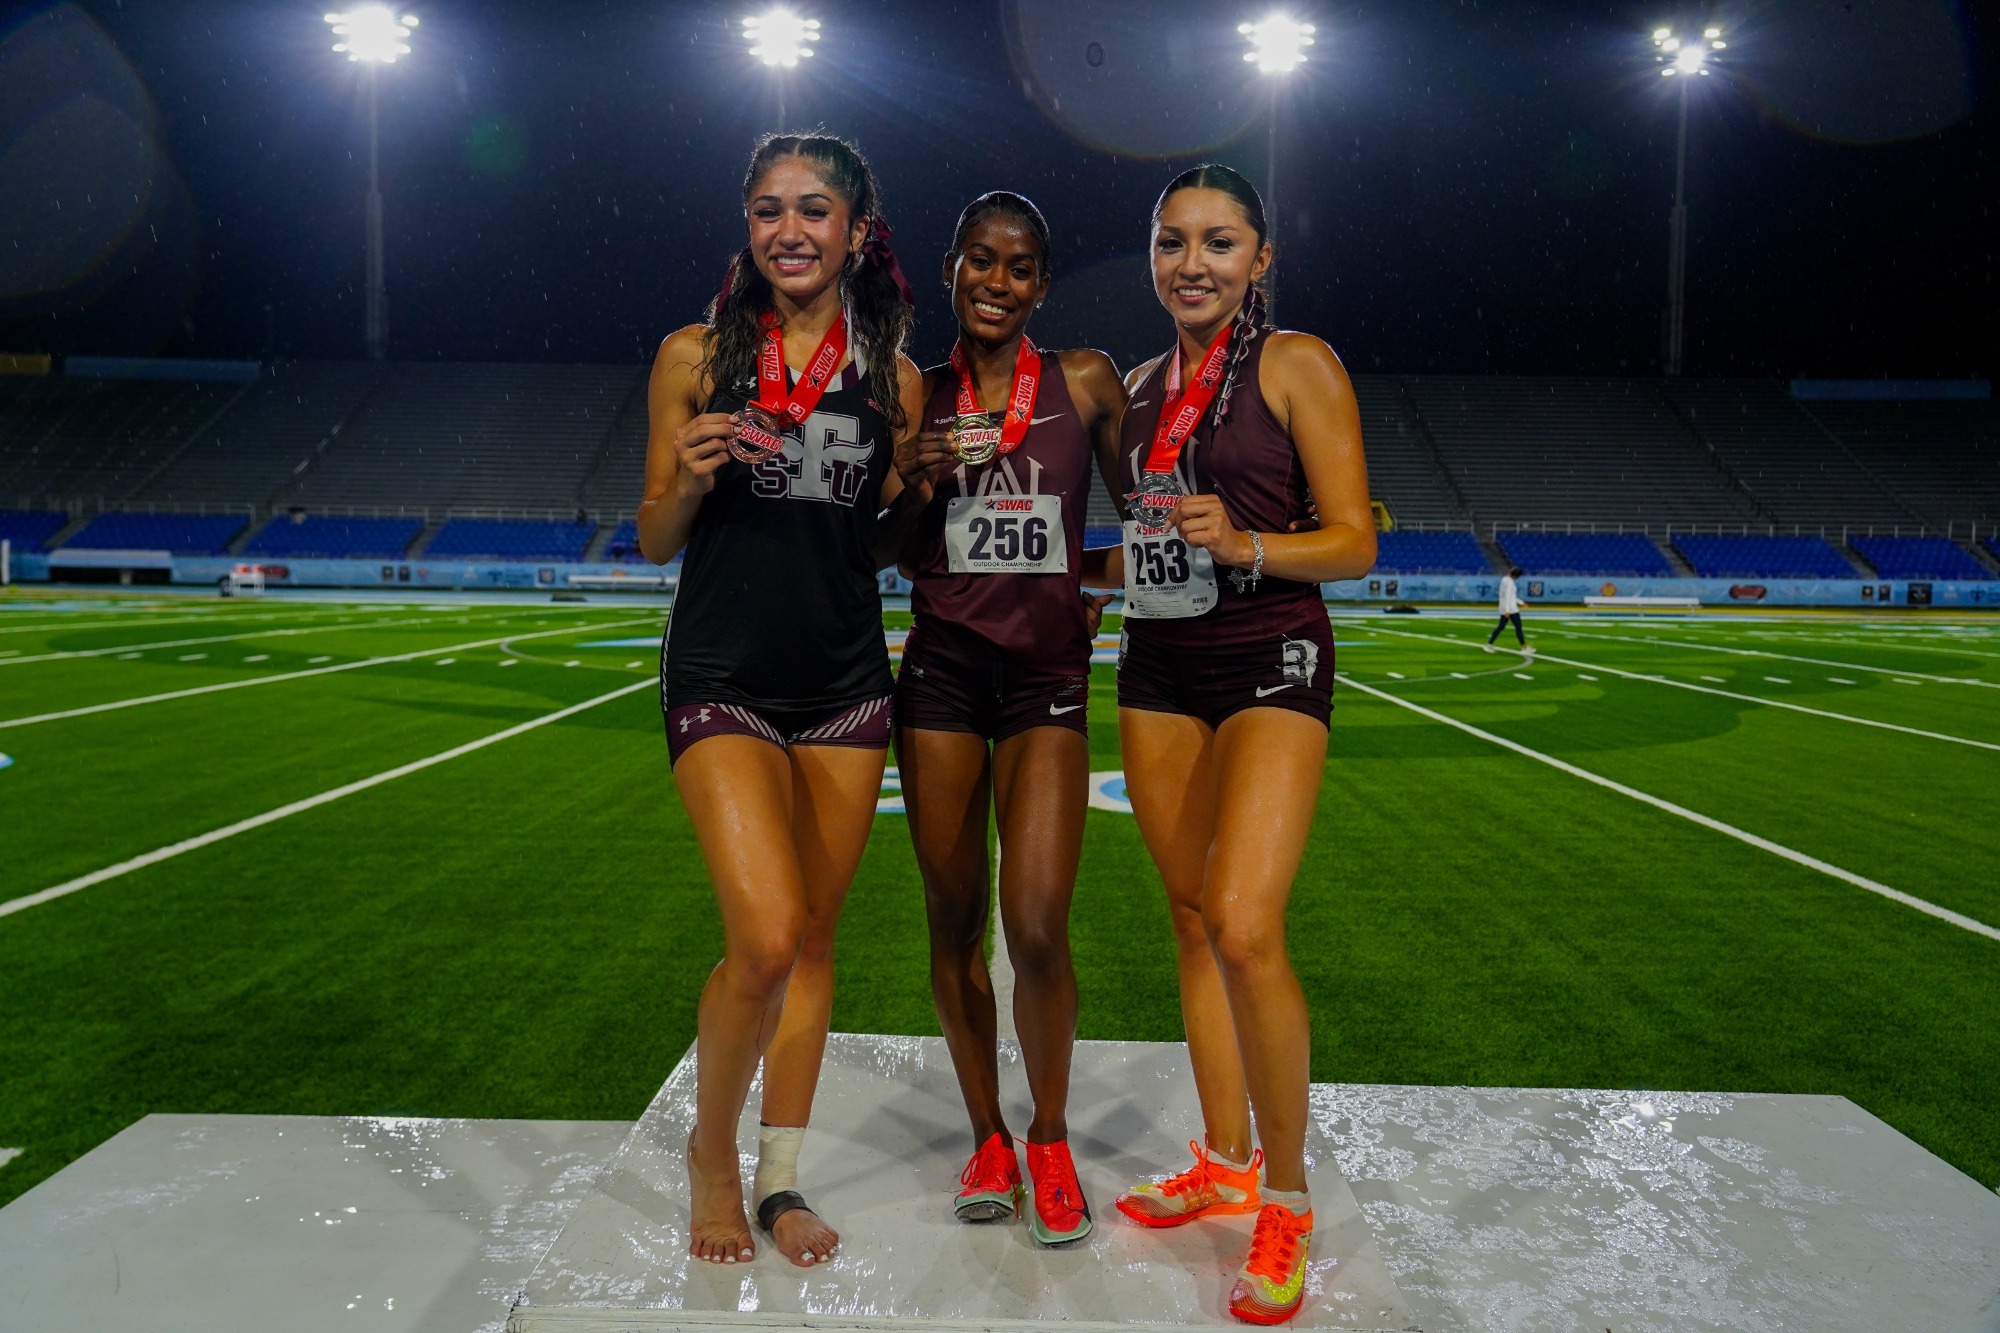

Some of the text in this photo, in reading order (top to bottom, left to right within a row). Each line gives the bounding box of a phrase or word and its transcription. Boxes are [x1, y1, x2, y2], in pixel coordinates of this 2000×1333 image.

[763, 346, 780, 380] SWAC
[812, 344, 837, 380] SWAC
[1204, 346, 1228, 380] SWAC
[1016, 374, 1035, 410] SWAC
[740, 425, 784, 452] SWAC
[960, 430, 1000, 444] SWAC
[1171, 406, 1198, 438] SWAC
[996, 499, 1034, 511] SWAC
[968, 517, 1047, 561] 256
[1131, 539, 1190, 585] 253
